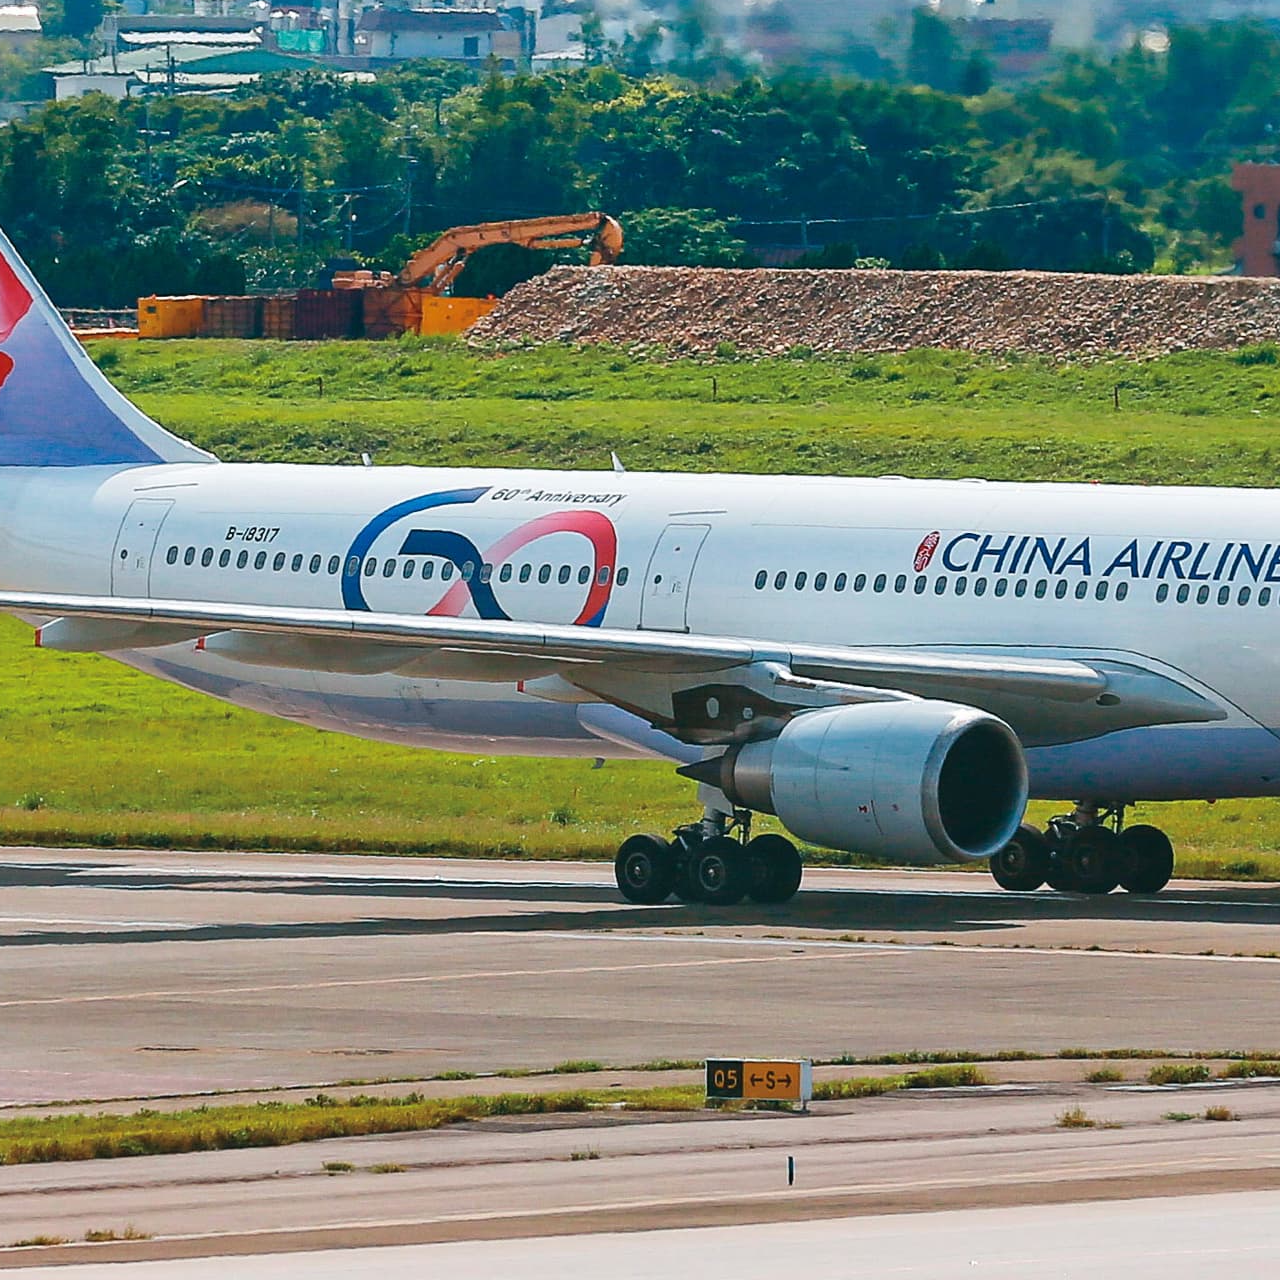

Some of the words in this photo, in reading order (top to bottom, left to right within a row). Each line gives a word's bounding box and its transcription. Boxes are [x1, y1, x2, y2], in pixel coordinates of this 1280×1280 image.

[525, 489, 627, 508] Anniversary
[225, 526, 280, 543] B-18317
[942, 532, 1091, 576] CHINA
[765, 1071, 775, 1090] S
